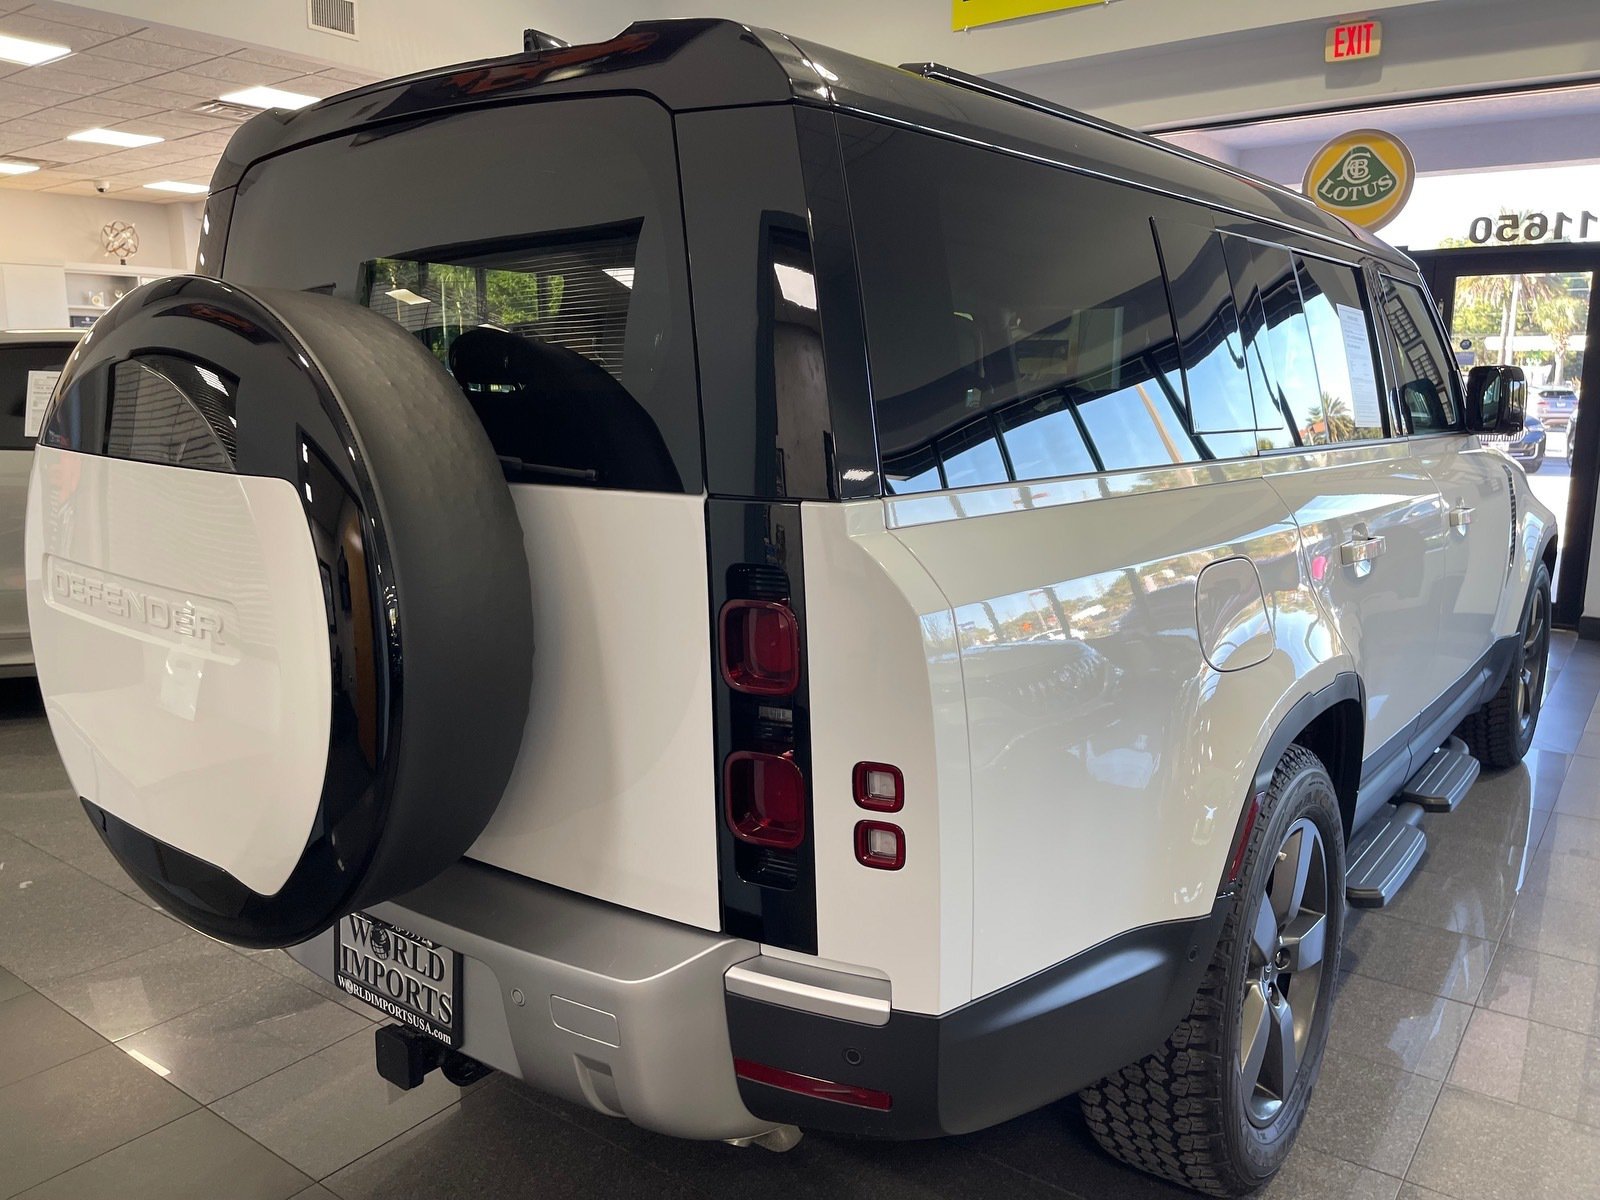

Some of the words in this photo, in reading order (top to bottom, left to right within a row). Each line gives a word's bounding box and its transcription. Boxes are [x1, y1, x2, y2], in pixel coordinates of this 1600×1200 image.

[1334, 23, 1374, 58] EXIT
[1319, 174, 1393, 201] LOTUS
[54, 566, 226, 646] DEFENDER
[350, 913, 446, 982] WORLD
[337, 974, 452, 1046] WORLDIMPORTSUSA.com
[342, 942, 453, 1025] IMPORTS
